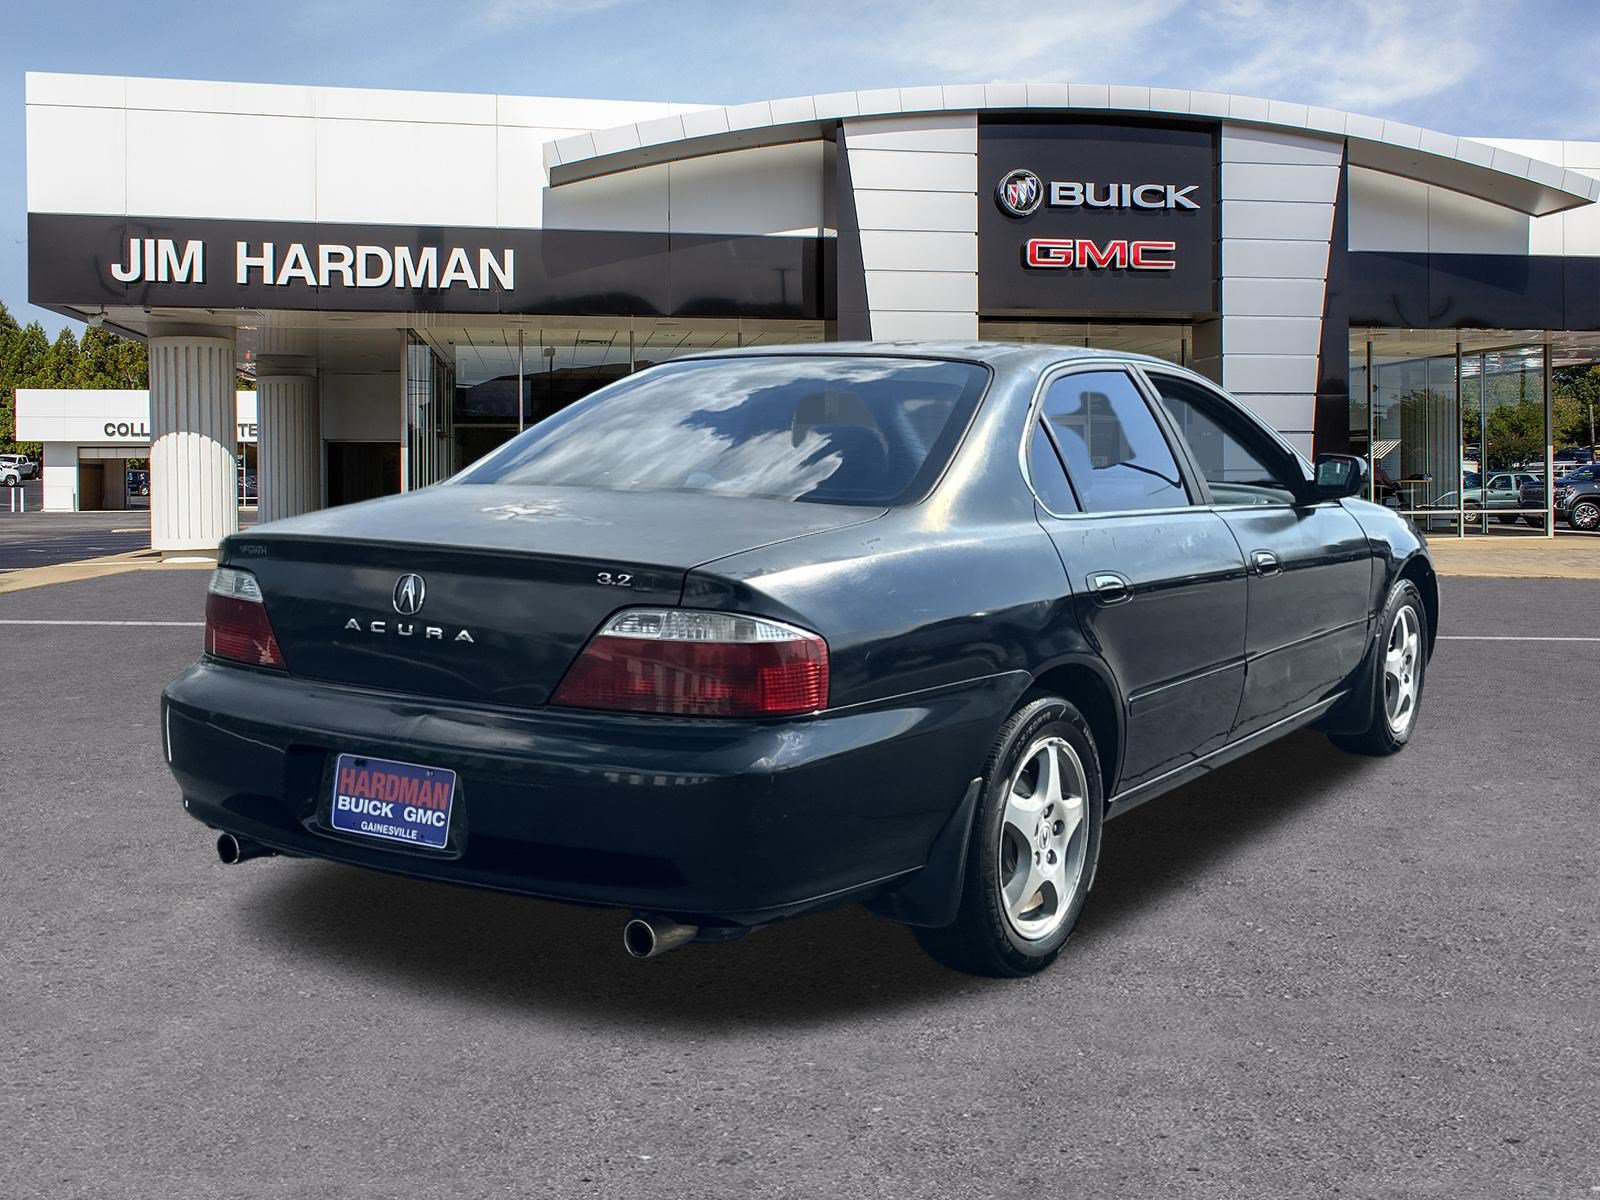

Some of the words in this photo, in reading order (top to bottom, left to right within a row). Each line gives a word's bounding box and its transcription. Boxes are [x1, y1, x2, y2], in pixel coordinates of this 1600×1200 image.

[1050, 181, 1200, 209] BUICK
[111, 238, 204, 283] JIM
[236, 241, 515, 291] HARDMAN
[1027, 238, 1176, 270] GMC
[104, 422, 150, 437] COLL
[238, 423, 257, 437] TE
[596, 572, 633, 587] 3.2
[344, 618, 475, 643] ACURA
[338, 767, 449, 810] HARDMAN
[337, 795, 395, 818] BUICK
[403, 806, 446, 827] GMC
[360, 820, 418, 840] GAINESVILLE
